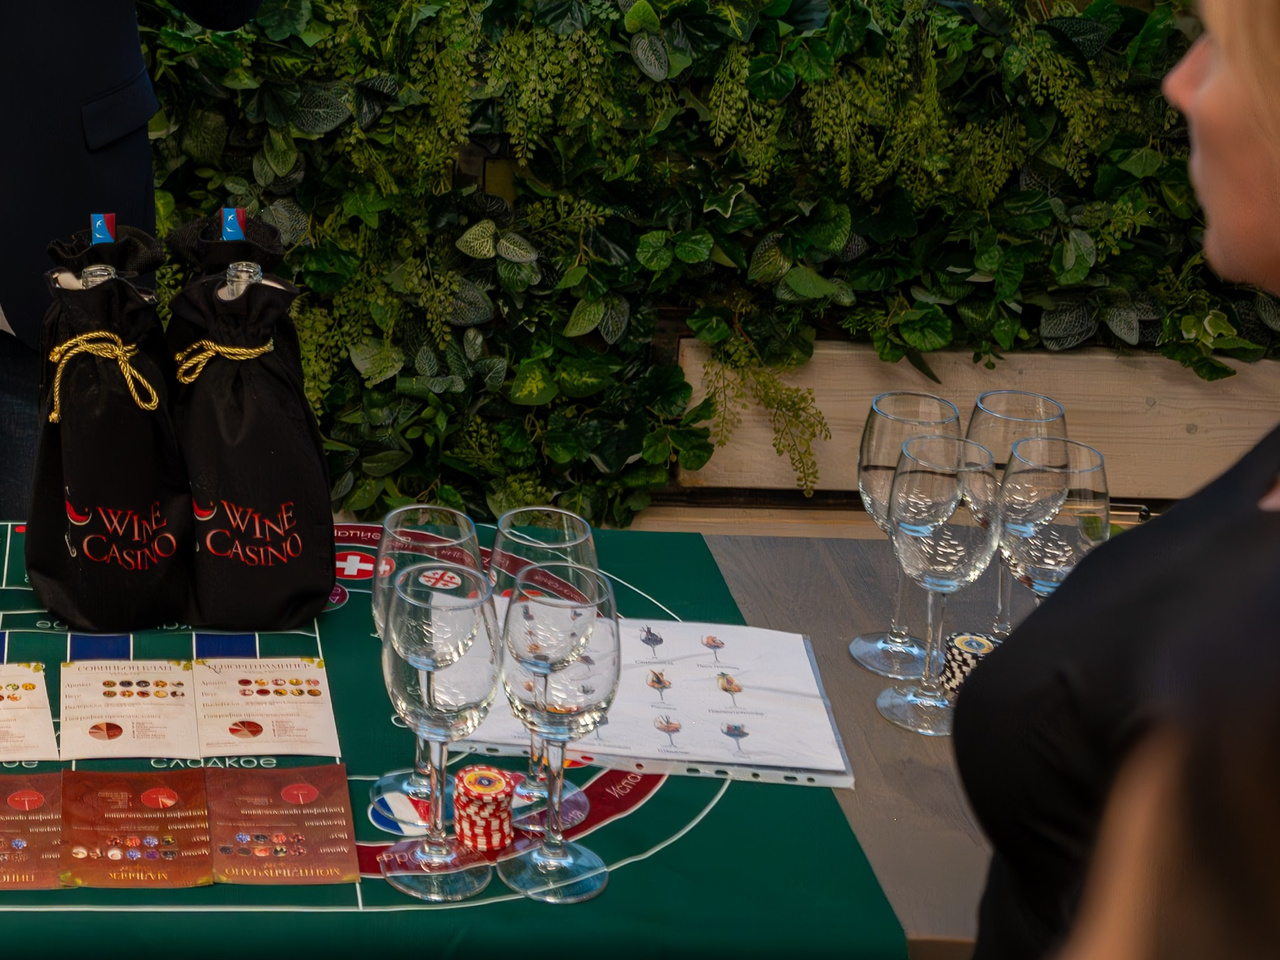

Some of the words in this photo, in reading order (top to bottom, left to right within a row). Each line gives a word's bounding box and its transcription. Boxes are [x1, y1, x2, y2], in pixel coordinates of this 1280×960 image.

[97, 501, 167, 543] WINE
[221, 499, 297, 541] WINE
[83, 533, 177, 570] CASINO
[206, 529, 302, 566] CASINO
[604, 772, 643, 799] Испа
